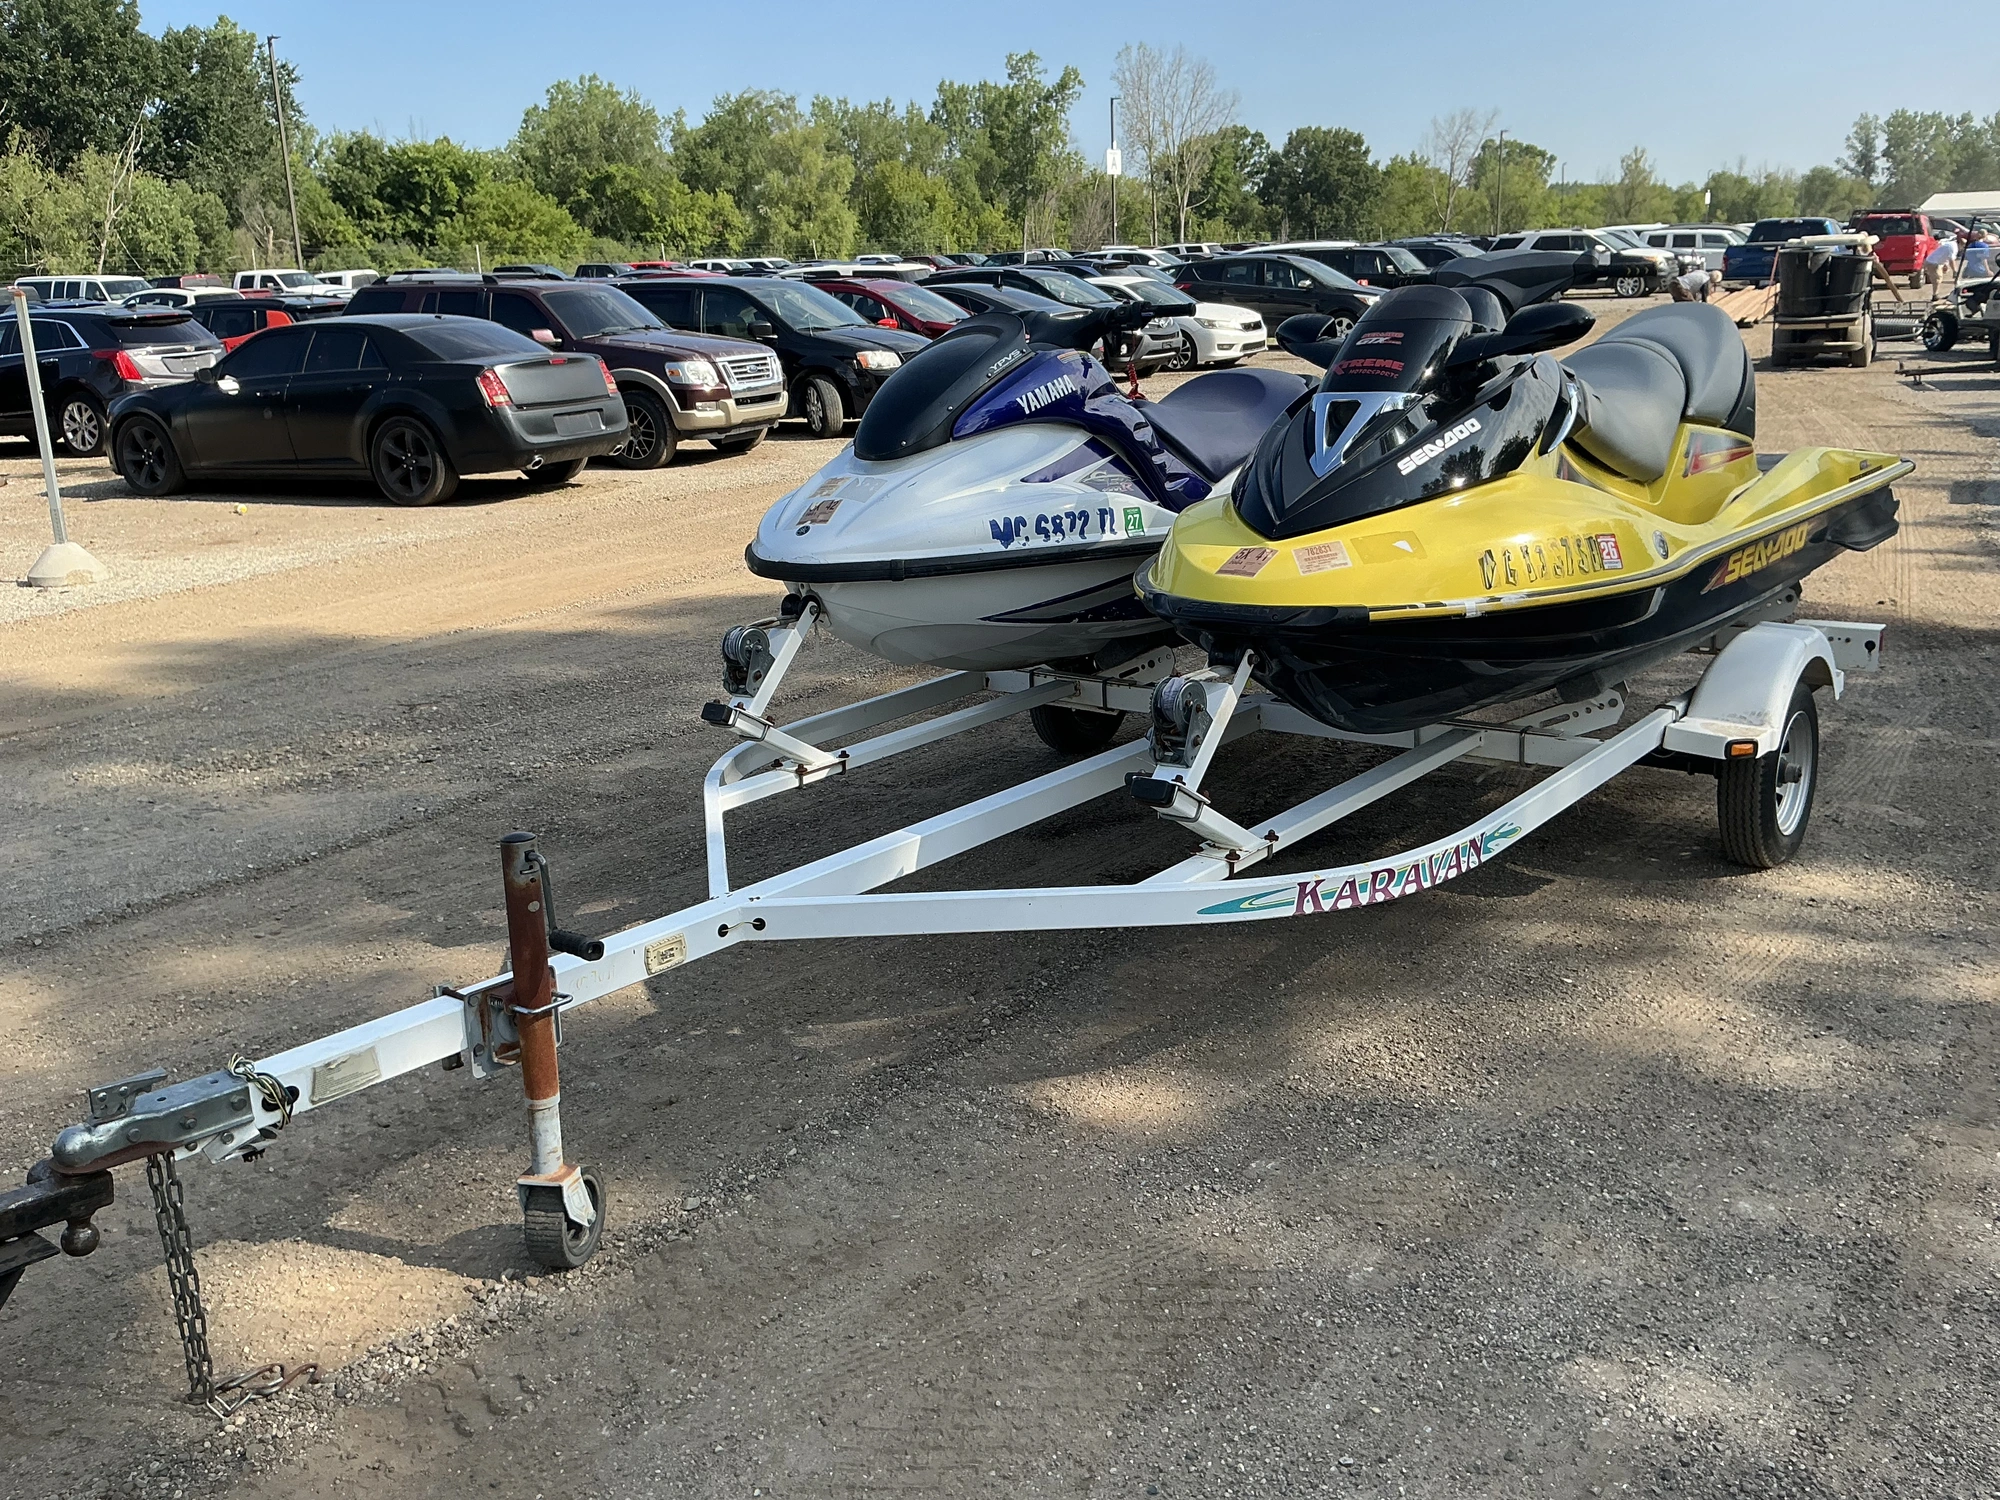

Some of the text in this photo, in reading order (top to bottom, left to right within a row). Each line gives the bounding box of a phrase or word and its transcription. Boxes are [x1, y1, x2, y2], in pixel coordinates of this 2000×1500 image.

[989, 348, 1021, 371] YPVS
[1015, 374, 1077, 415] YAMAHA
[1127, 513, 1140, 530] 27
[1599, 541, 1618, 560] 26
[1292, 831, 1486, 916] KARAVAN
